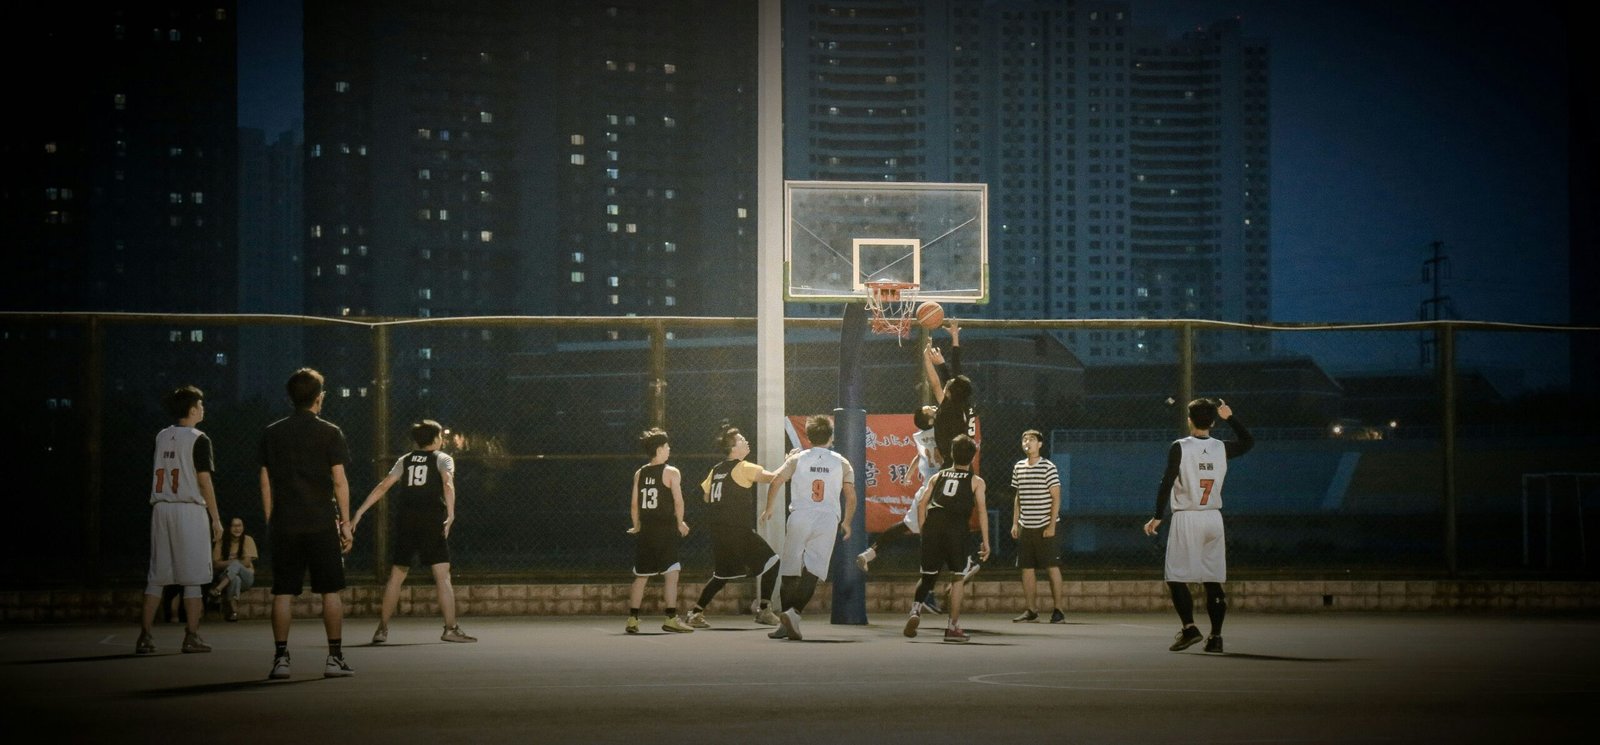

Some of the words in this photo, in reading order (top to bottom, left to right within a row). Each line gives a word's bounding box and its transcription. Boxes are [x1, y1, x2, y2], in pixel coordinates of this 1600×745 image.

[155, 468, 180, 495] 11
[407, 464, 428, 487] 19
[941, 470, 969, 479] LINZZY
[640, 487, 659, 510] 13
[710, 481, 723, 503] 14
[811, 479, 825, 503] 9
[942, 479, 959, 497] 0
[1199, 478, 1215, 506] 7
